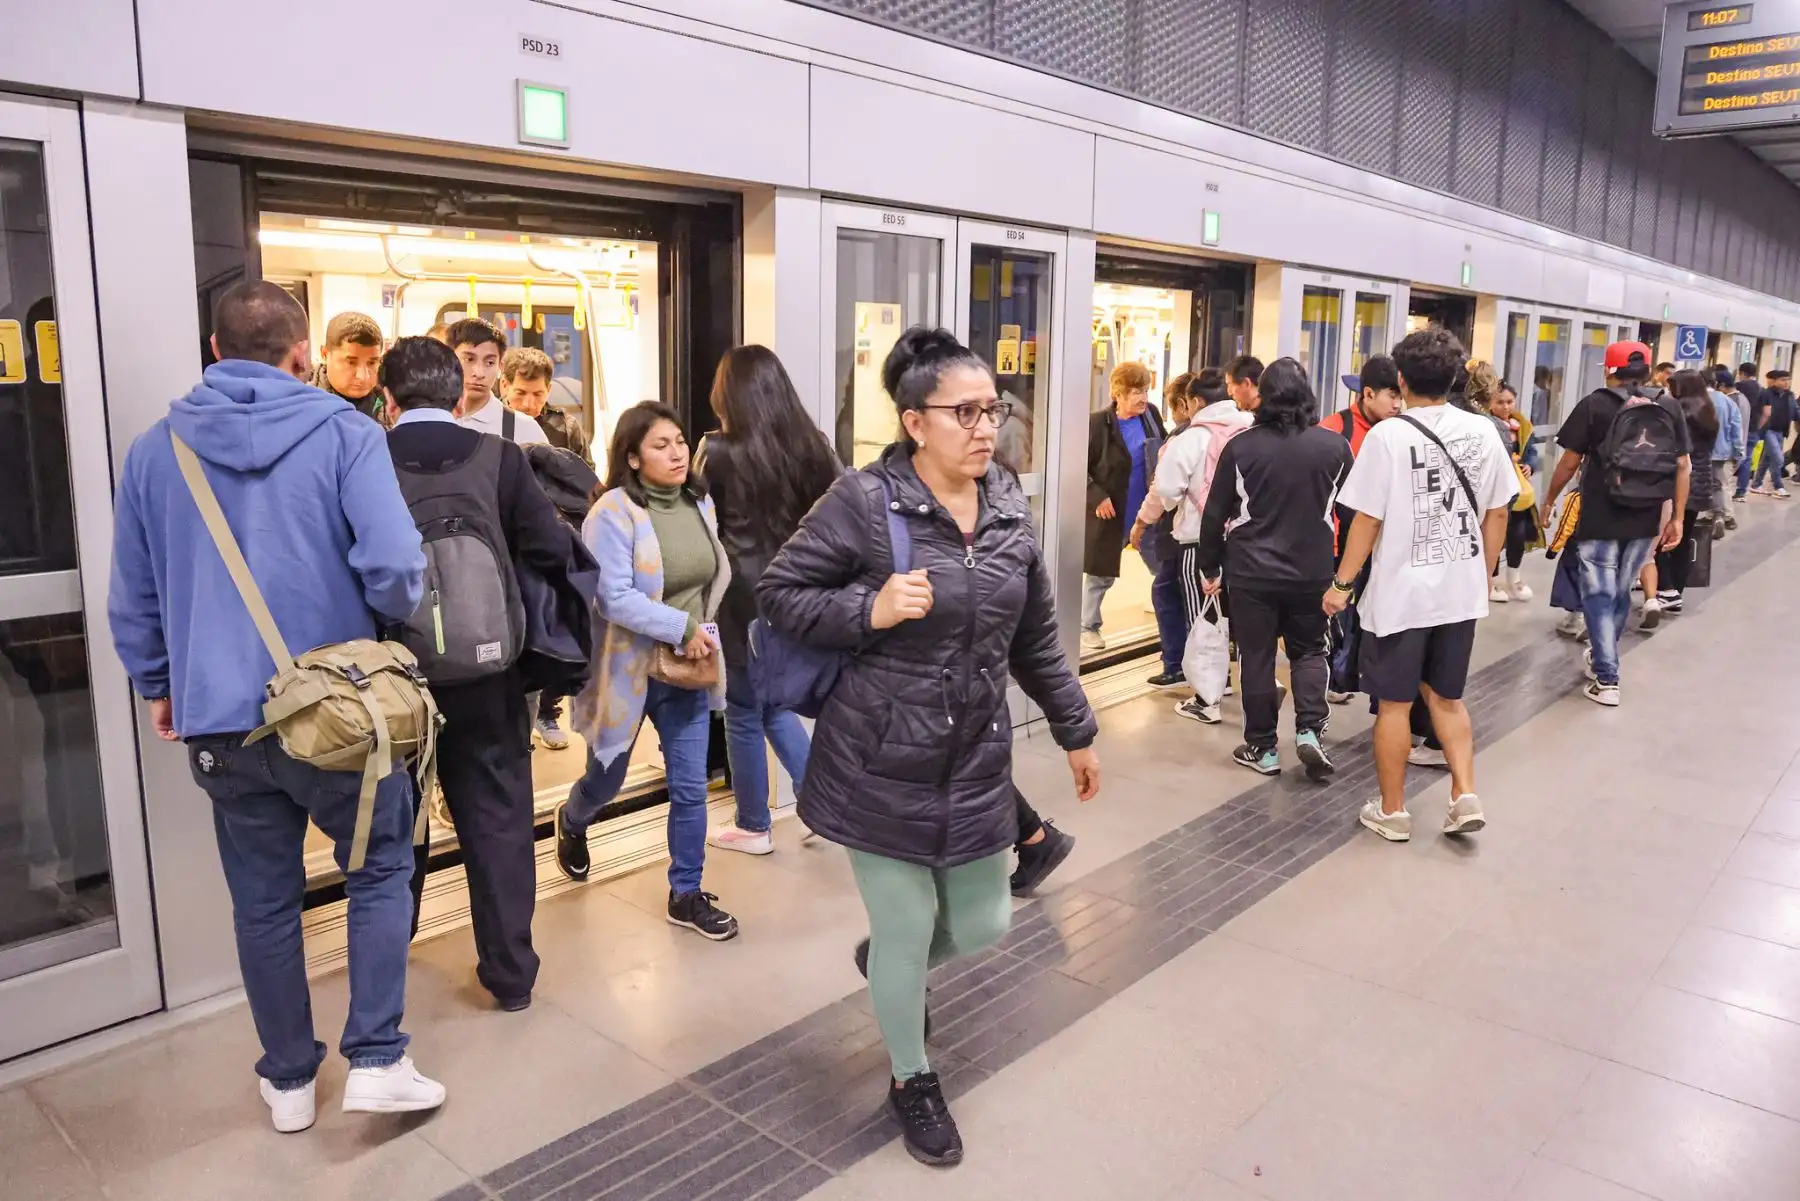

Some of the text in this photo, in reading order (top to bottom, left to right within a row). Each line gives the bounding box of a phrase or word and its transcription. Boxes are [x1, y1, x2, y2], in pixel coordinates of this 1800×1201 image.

[1703, 9, 1738, 25] 11:07
[522, 37, 559, 57] PSD 23
[1709, 42, 1763, 58] Destino
[1706, 69, 1760, 84] Destino
[1703, 95, 1757, 110] Destino
